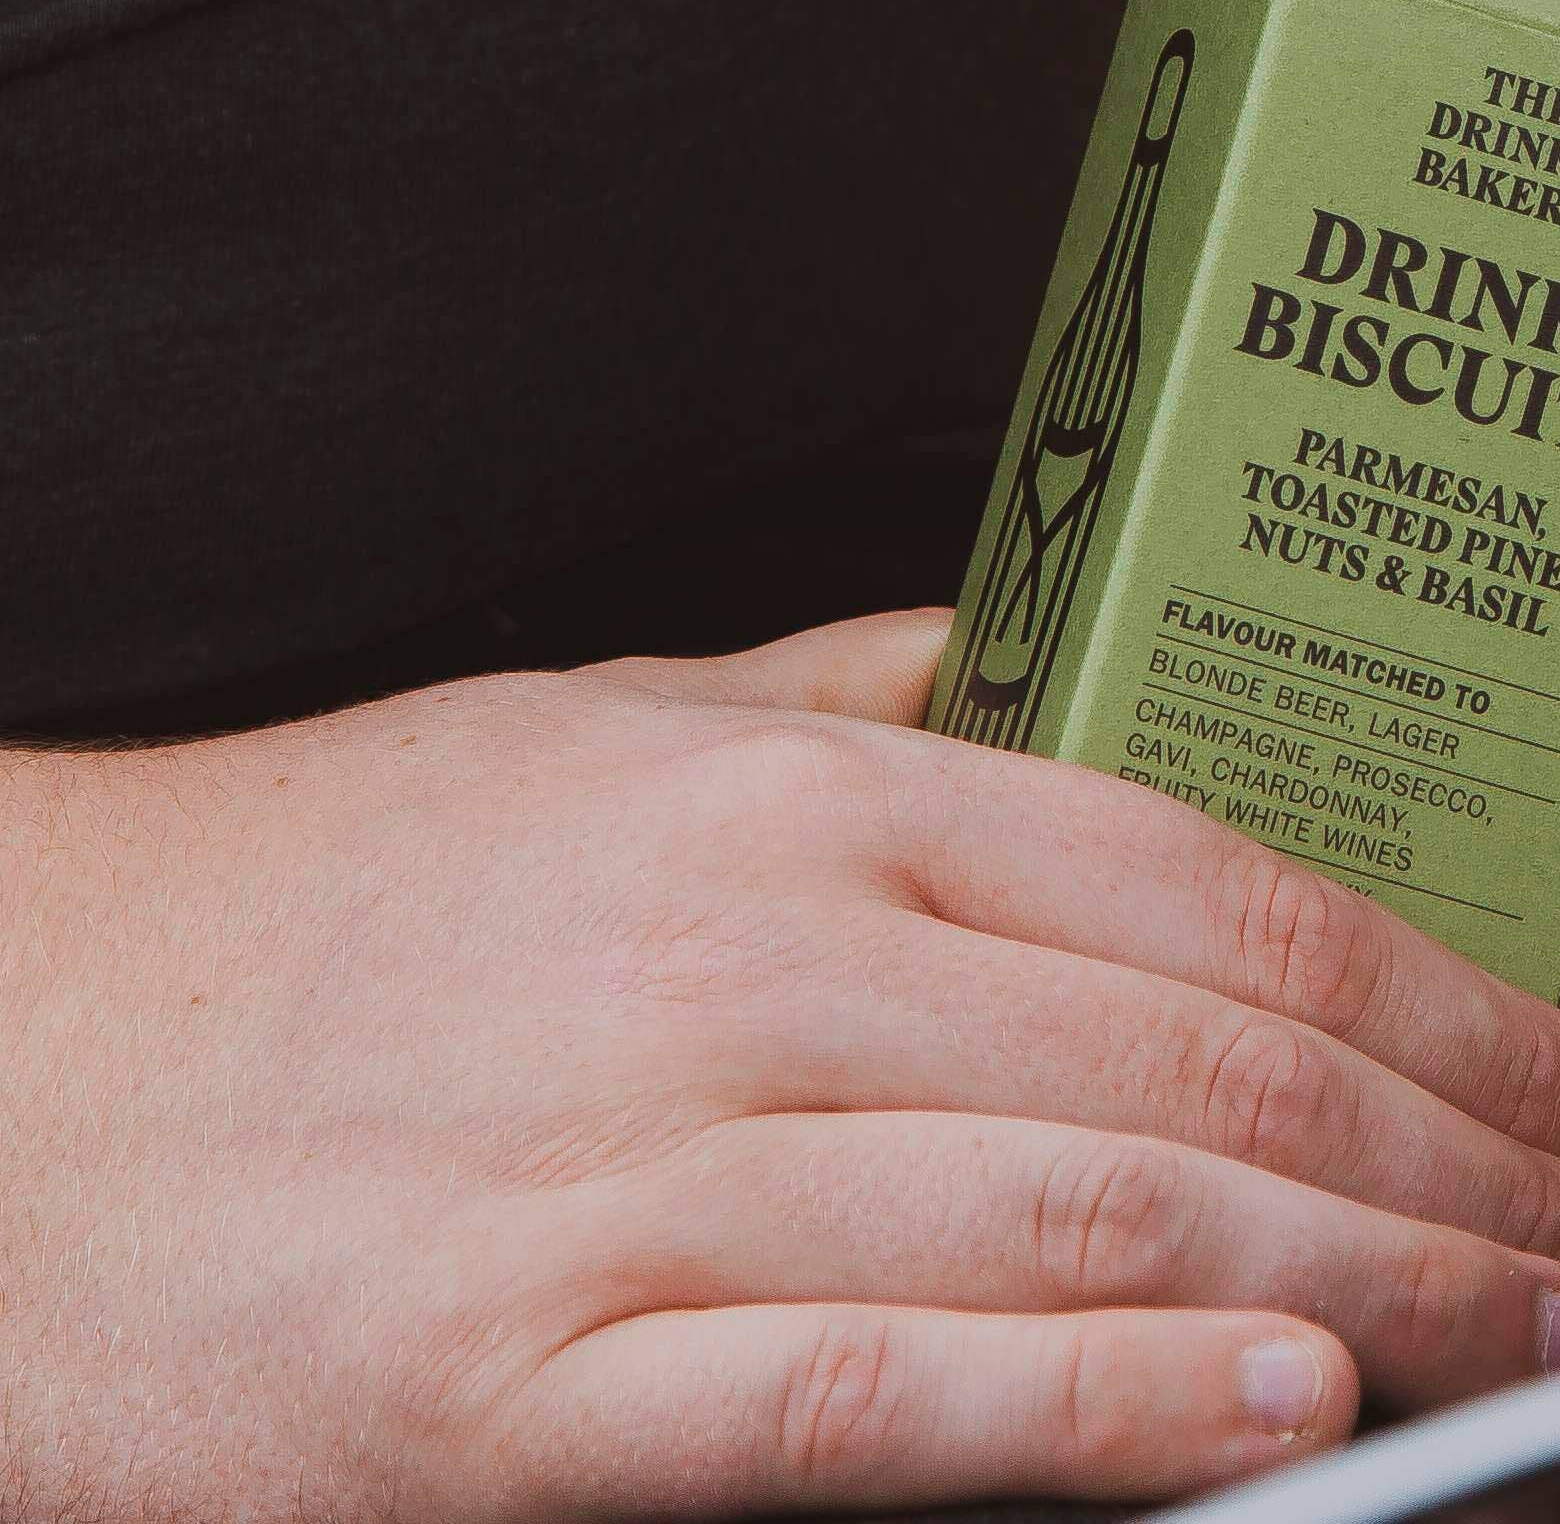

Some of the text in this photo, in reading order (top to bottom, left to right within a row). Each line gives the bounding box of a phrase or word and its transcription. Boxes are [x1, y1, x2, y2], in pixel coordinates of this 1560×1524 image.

[1241, 462, 1452, 552] TOASTED
[1292, 428, 1548, 540] PARMESAN,
[1239, 514, 1551, 637] NUTS & BASIL
[1149, 649, 1460, 759] BLONDE BEER, LAGER
[1162, 599, 1491, 715] FLAVOUR MATCHED TO
[1125, 734, 1413, 838] GAVI, CHARDONNAY,
[1135, 697, 1494, 825] CHAMPAGNE, PROSECCO,
[1224, 796, 1314, 844] WHITE
[1323, 825, 1415, 872] WINES
